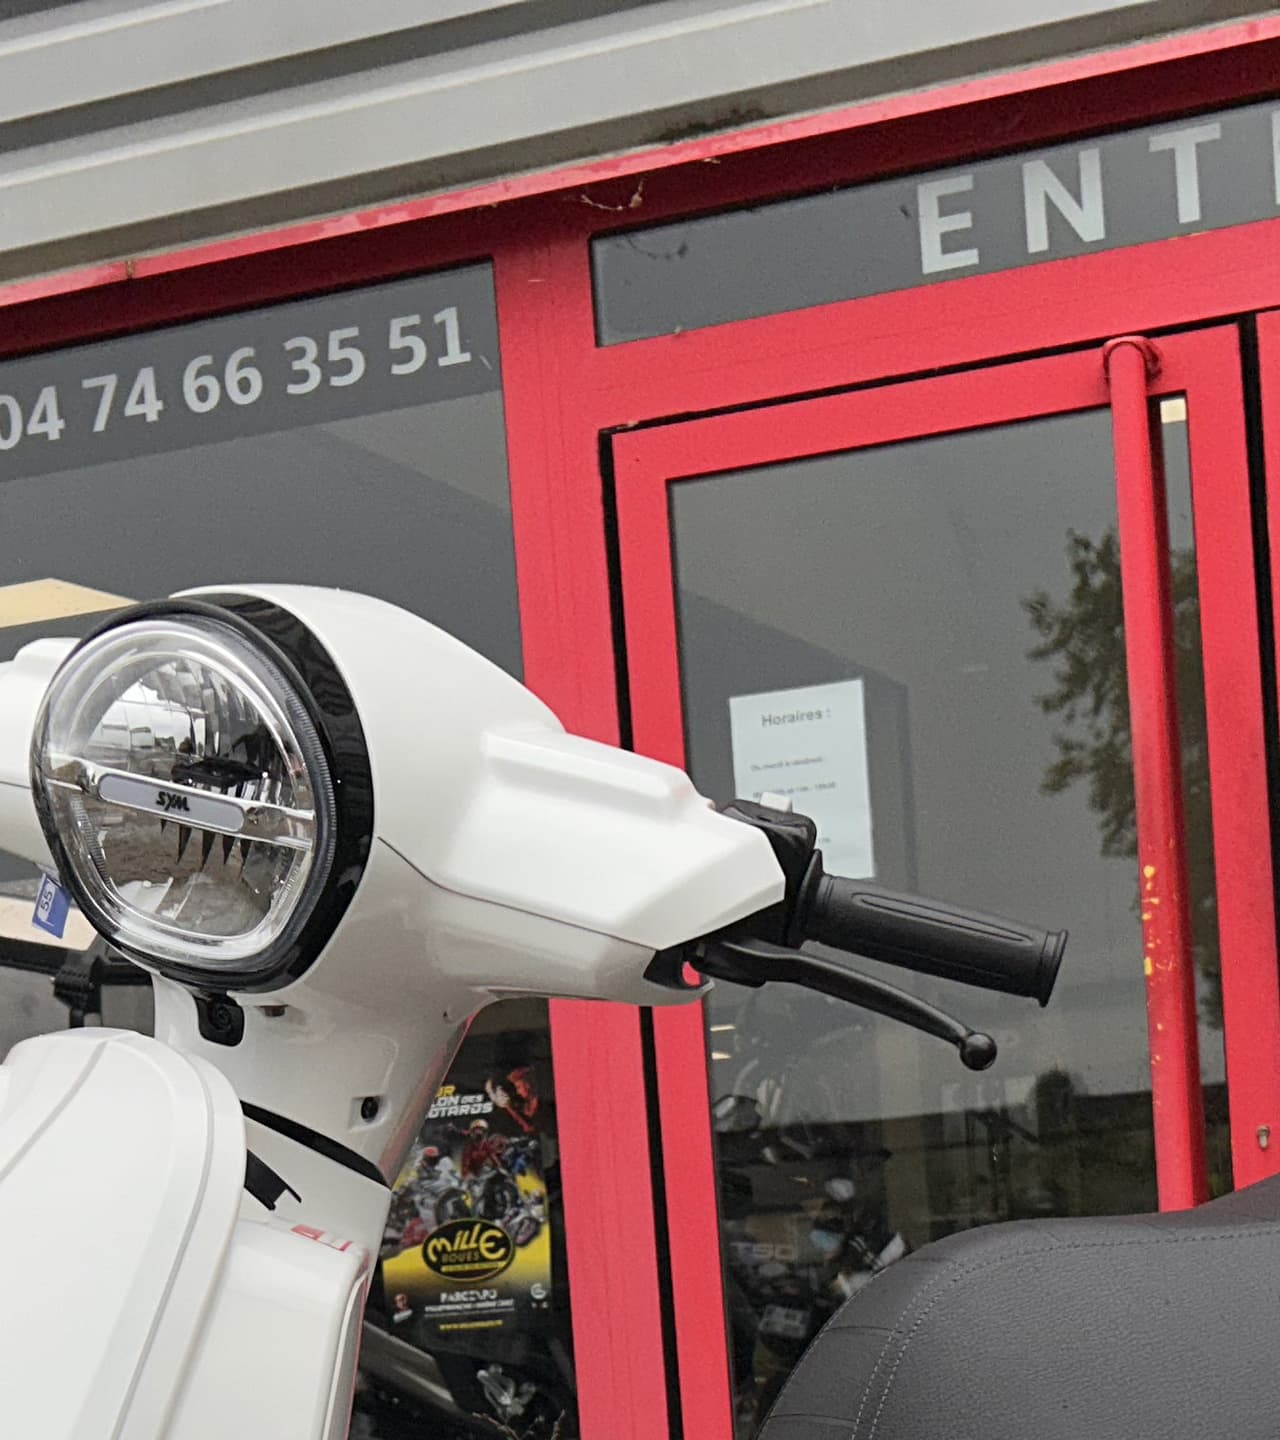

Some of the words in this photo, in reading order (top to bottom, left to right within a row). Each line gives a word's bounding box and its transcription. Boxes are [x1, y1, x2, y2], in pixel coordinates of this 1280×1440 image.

[81, 367, 164, 433] 74
[182, 346, 264, 414] 66
[283, 326, 366, 395] 35
[388, 306, 472, 376] 51
[761, 708, 823, 727] Horaires
[155, 790, 191, 812] SYM
[426, 1102, 494, 1120] OTARDS
